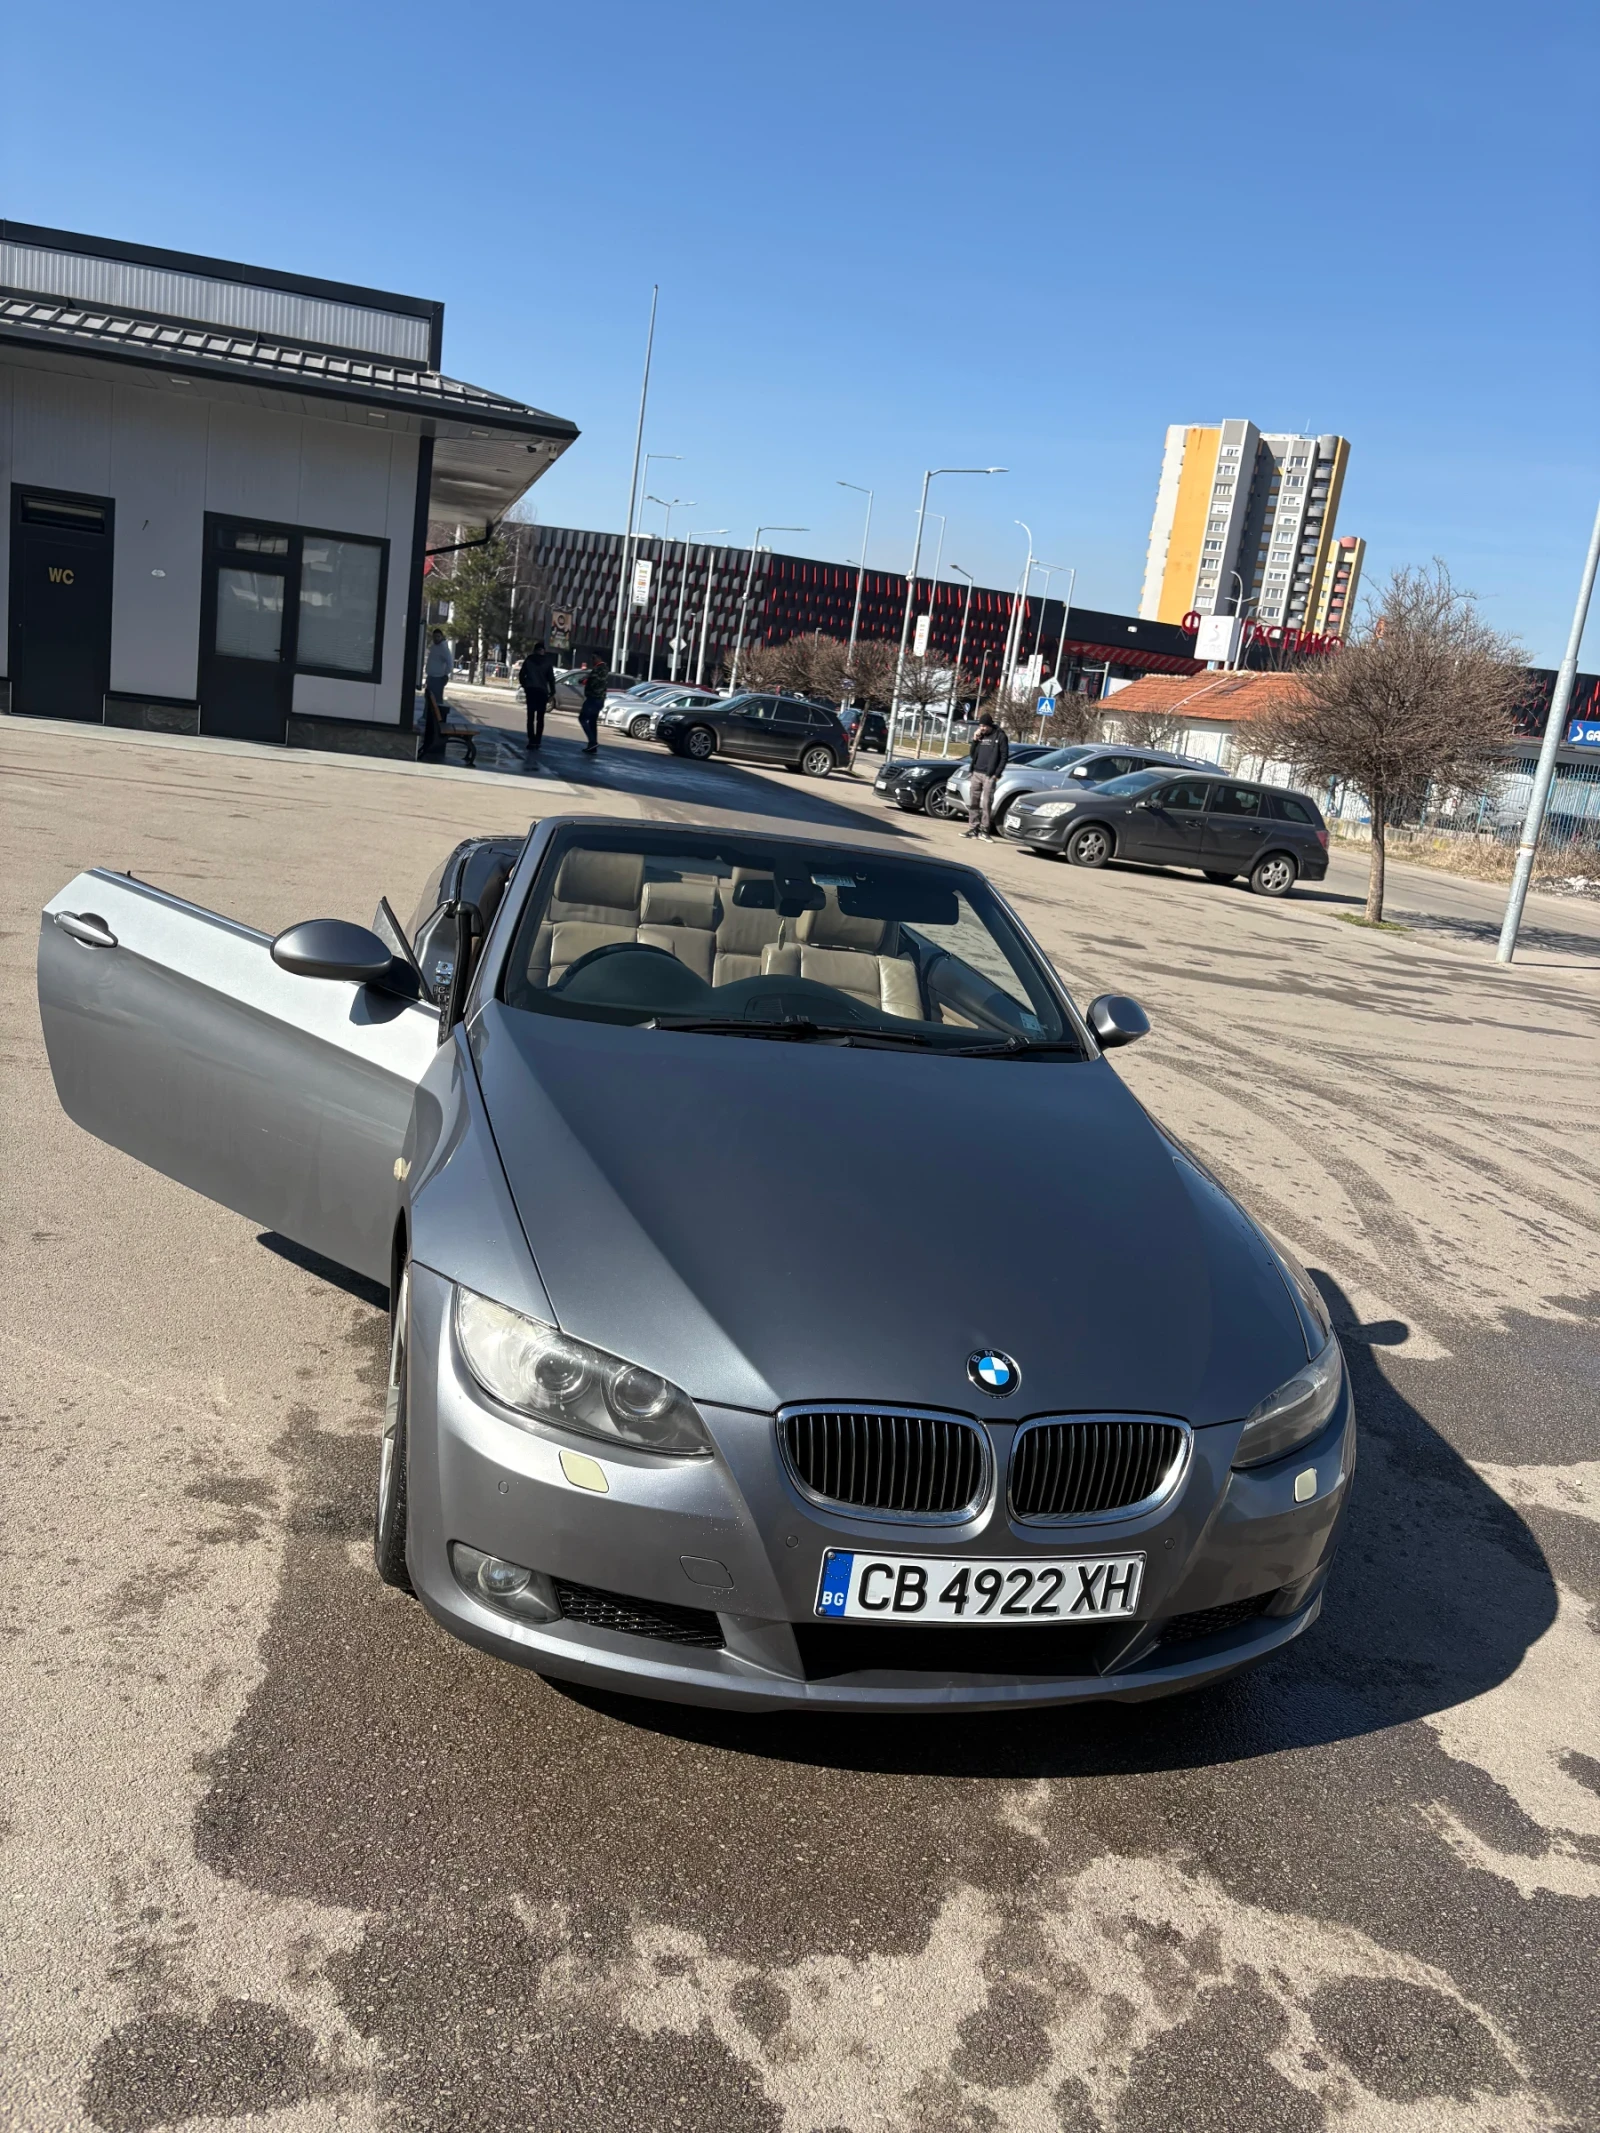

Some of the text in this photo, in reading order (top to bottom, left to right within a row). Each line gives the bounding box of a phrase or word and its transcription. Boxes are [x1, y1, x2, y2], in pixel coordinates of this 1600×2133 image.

[48, 566, 75, 585] WC
[1182, 611, 1343, 655] ФТАСТИКО
[971, 1351, 1010, 1364] BMW
[821, 1591, 845, 1606] BG
[858, 1563, 1135, 1615] CB 4922 XH
